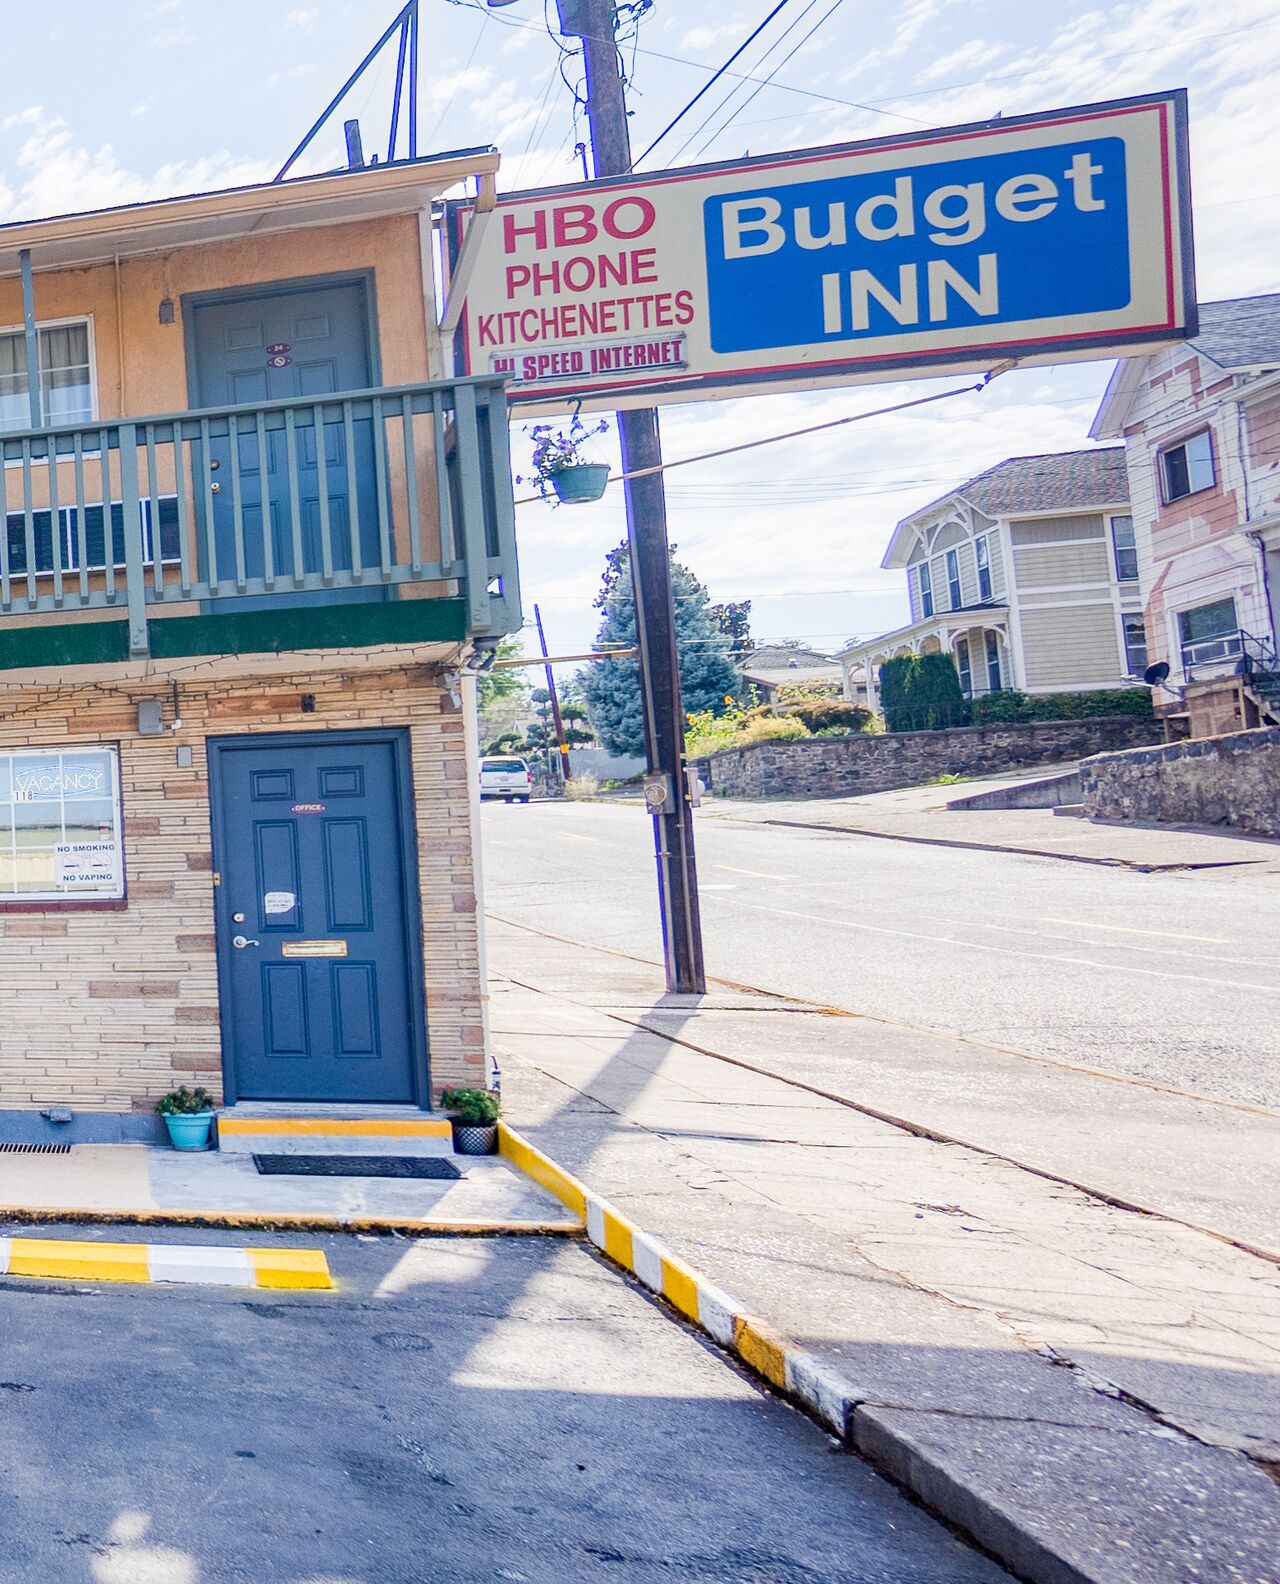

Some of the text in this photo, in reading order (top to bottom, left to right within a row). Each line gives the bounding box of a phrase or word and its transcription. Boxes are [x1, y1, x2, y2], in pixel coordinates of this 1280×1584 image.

[503, 196, 656, 254] HBO
[721, 152, 1107, 261] Budget
[506, 248, 658, 299] PHONE
[821, 252, 1000, 335] INN
[478, 290, 694, 347] KITCHENETTES
[523, 350, 583, 380] SPEED
[591, 340, 683, 374] INTERNET
[15, 773, 104, 791] VACANCY
[73, 844, 115, 852] SMOKING
